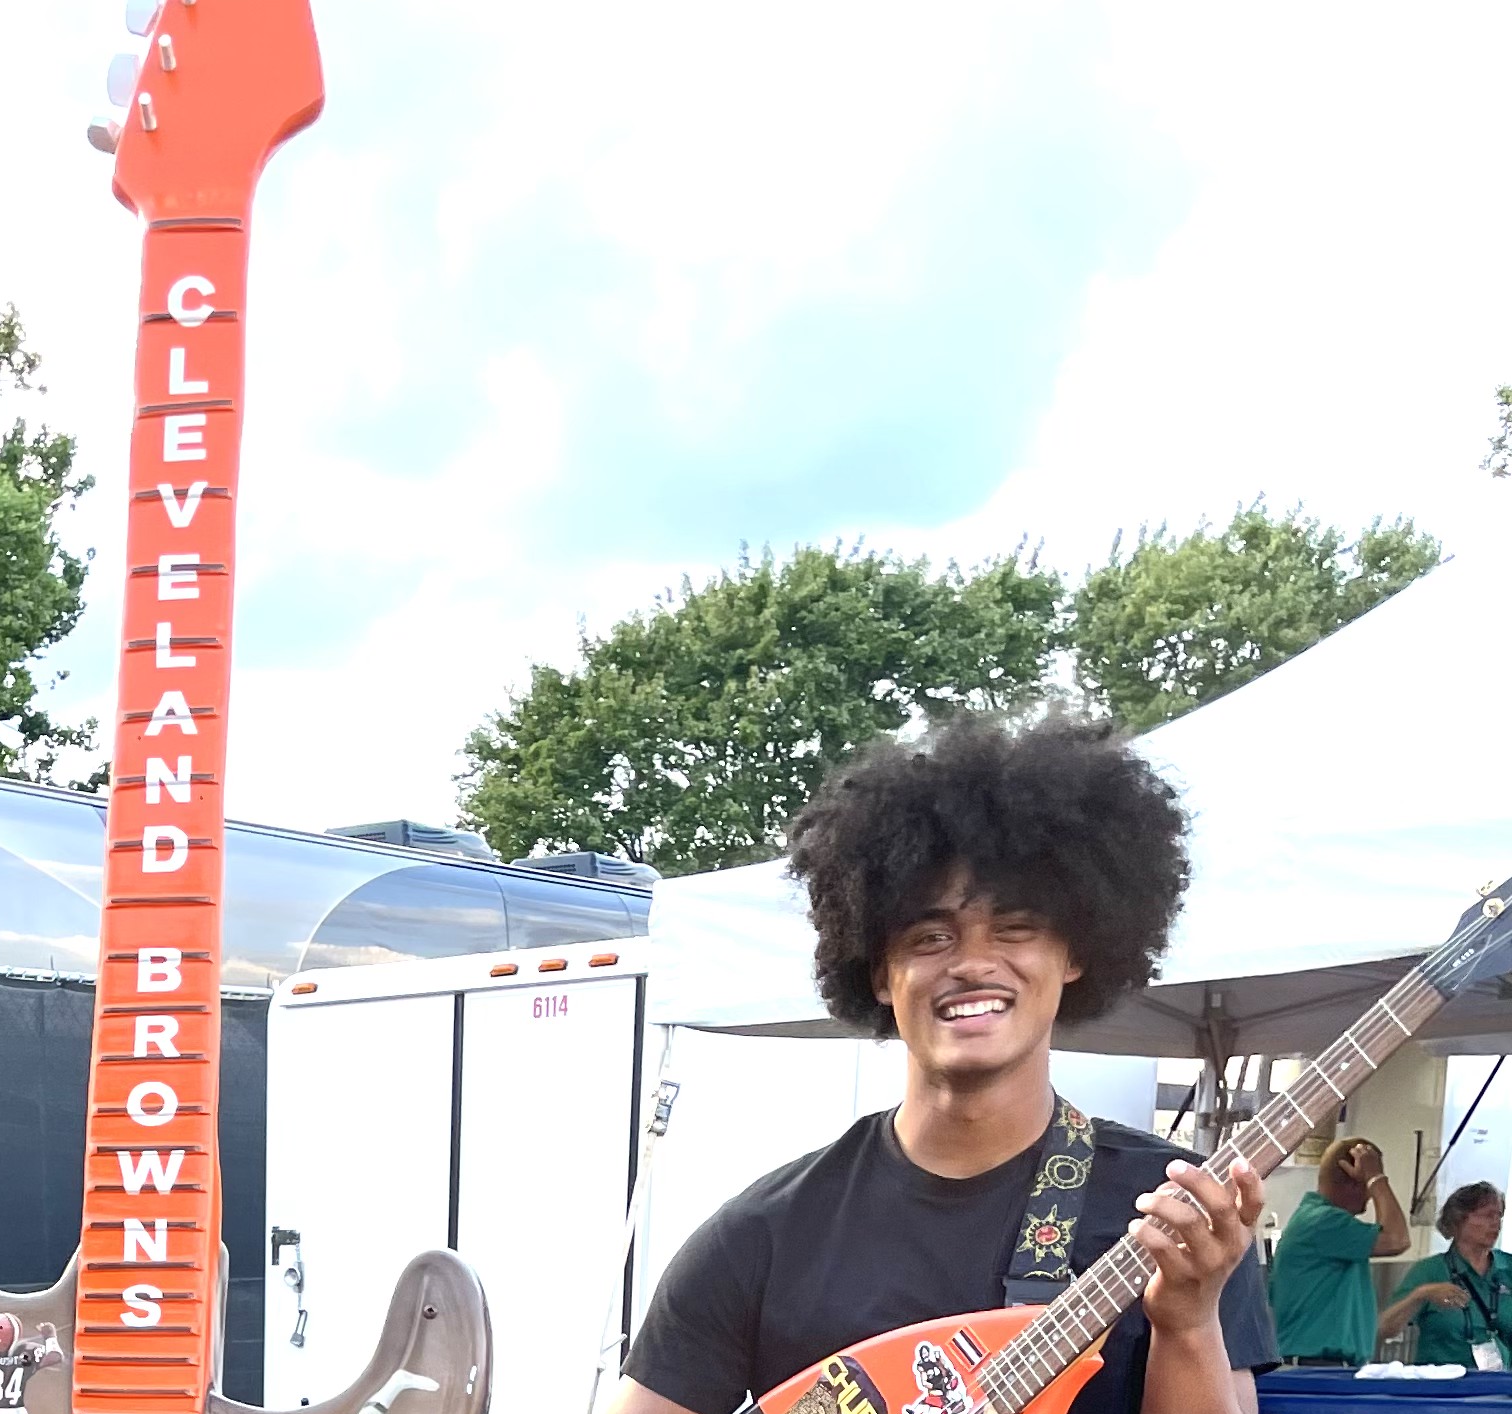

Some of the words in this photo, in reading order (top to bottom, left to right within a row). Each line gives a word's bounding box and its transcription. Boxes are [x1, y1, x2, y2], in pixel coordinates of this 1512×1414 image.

[144, 275, 216, 873] CLEVELAND
[116, 947, 185, 1328] BROWNS
[533, 995, 569, 1019] 6114
